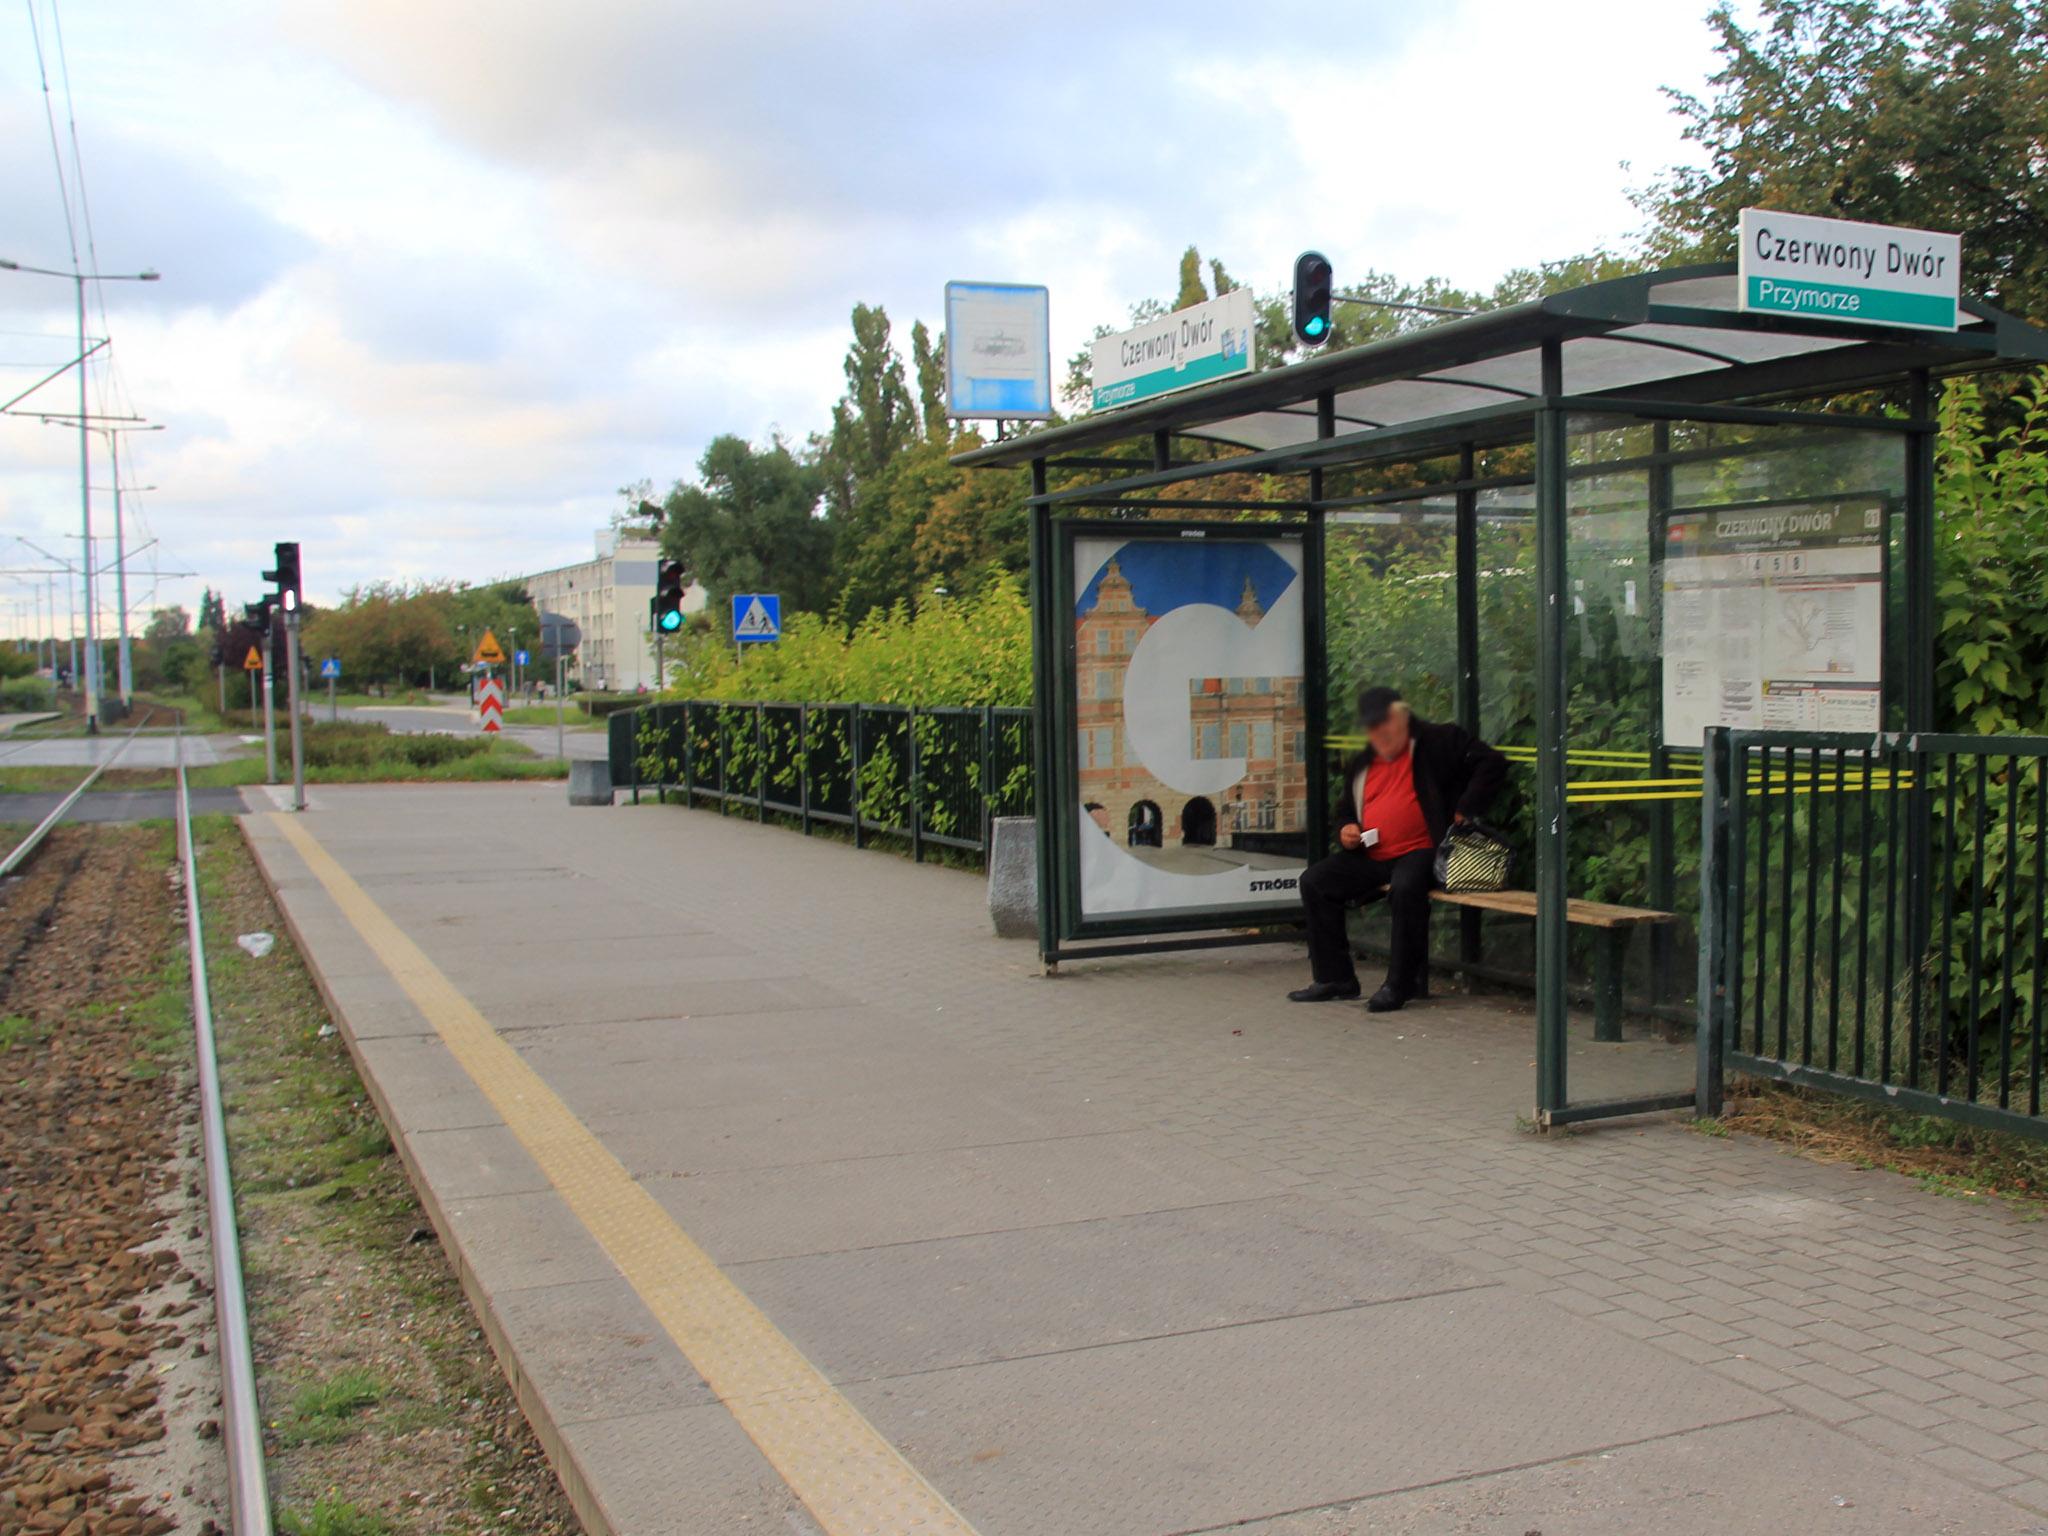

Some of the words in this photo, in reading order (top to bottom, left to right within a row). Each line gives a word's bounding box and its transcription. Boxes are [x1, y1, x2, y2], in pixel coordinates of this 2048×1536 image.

[1756, 227, 1876, 279] Czerwony
[1887, 242, 1945, 278] Dwór
[1759, 279, 1861, 311] Przymorze
[1121, 329, 1177, 367] Czerwony
[1181, 312, 1214, 348] Dwór
[1097, 382, 1136, 406] Przymorze
[1789, 511, 1832, 533] DWÓR
